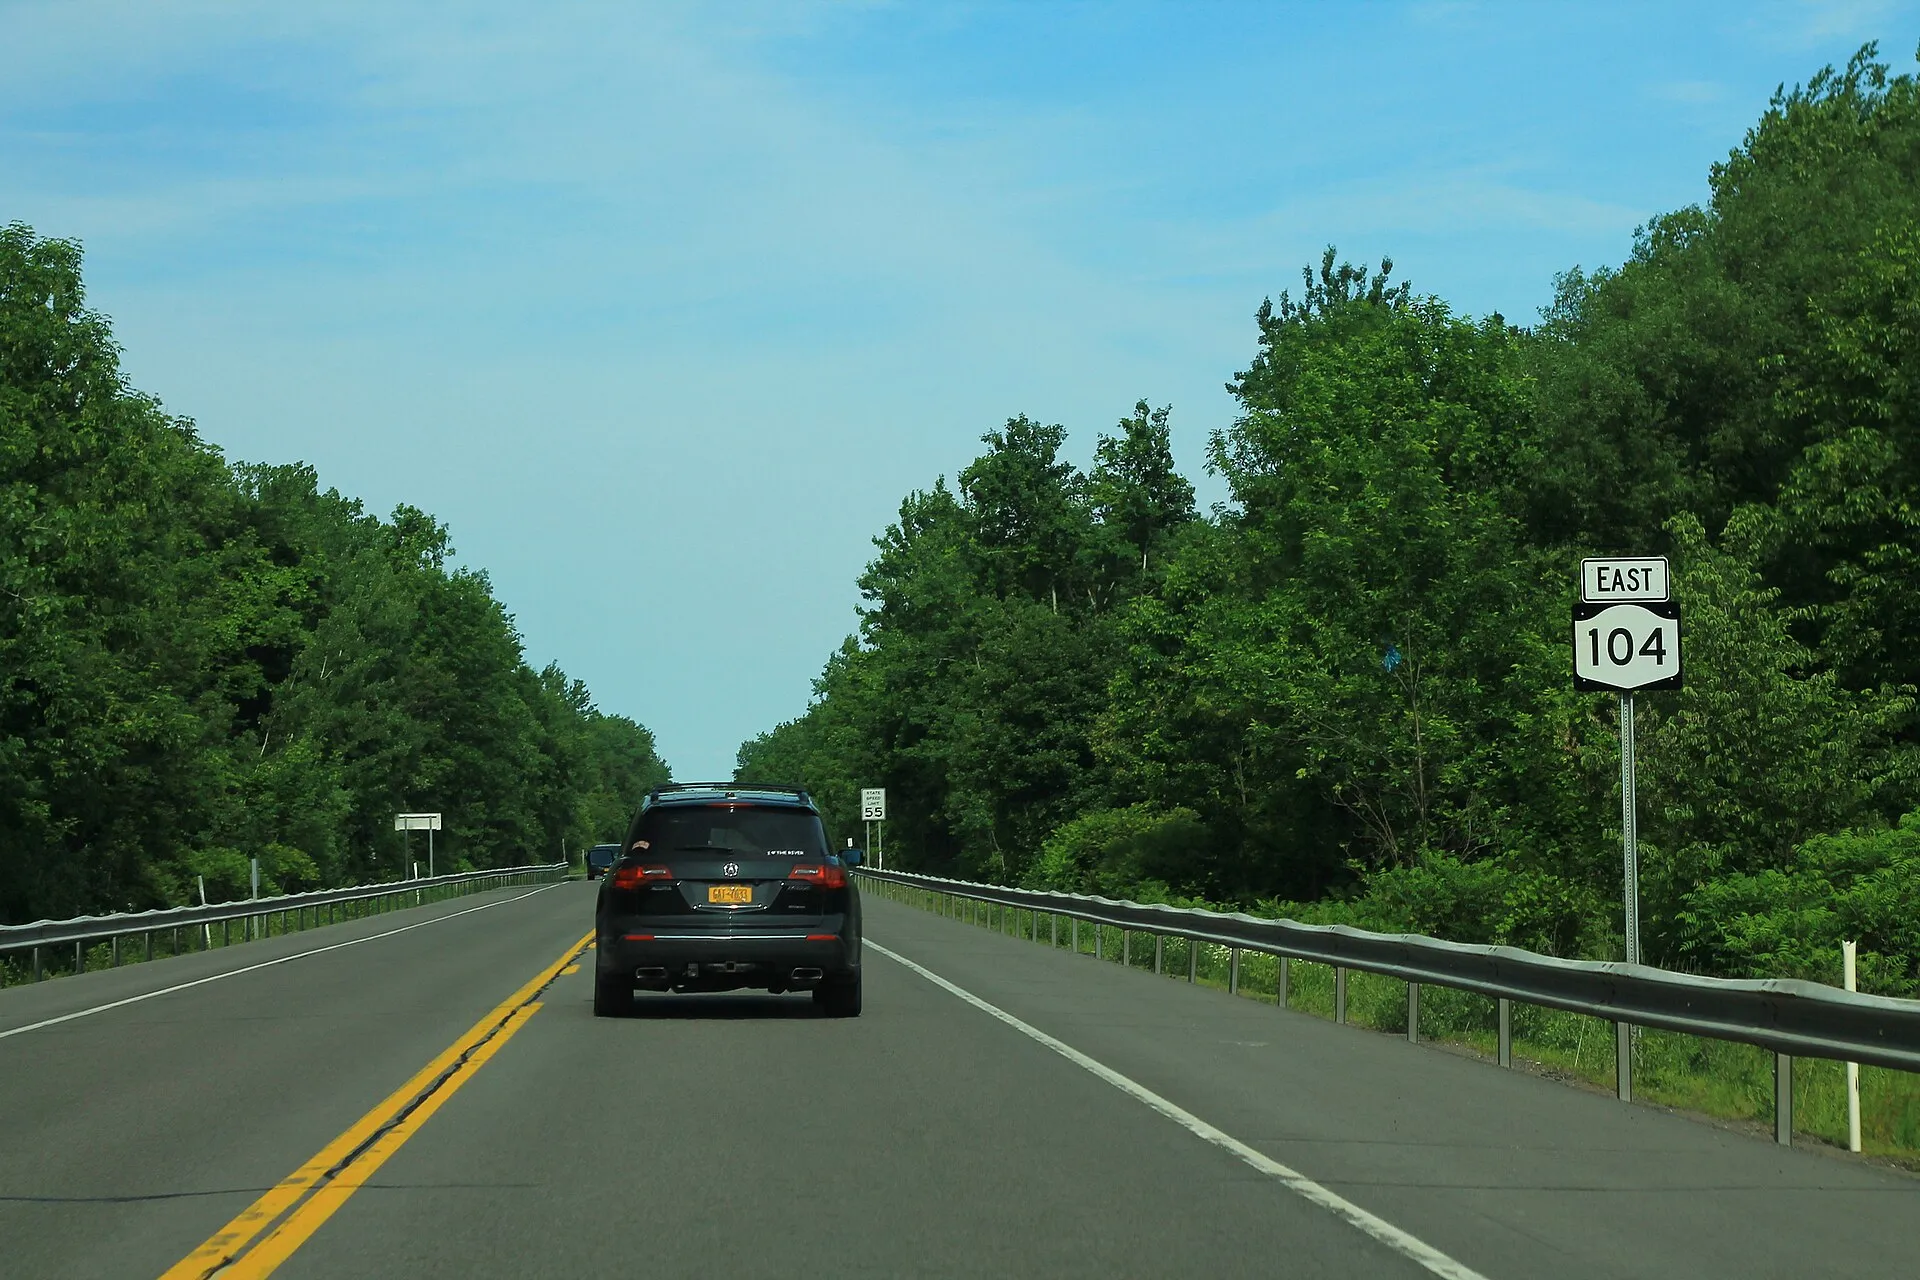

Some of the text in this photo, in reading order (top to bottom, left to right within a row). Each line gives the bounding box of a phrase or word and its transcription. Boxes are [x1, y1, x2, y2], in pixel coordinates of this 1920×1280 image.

[1597, 566, 1653, 592] EAST
[1588, 627, 1667, 666] 104
[865, 807, 883, 818] 55
